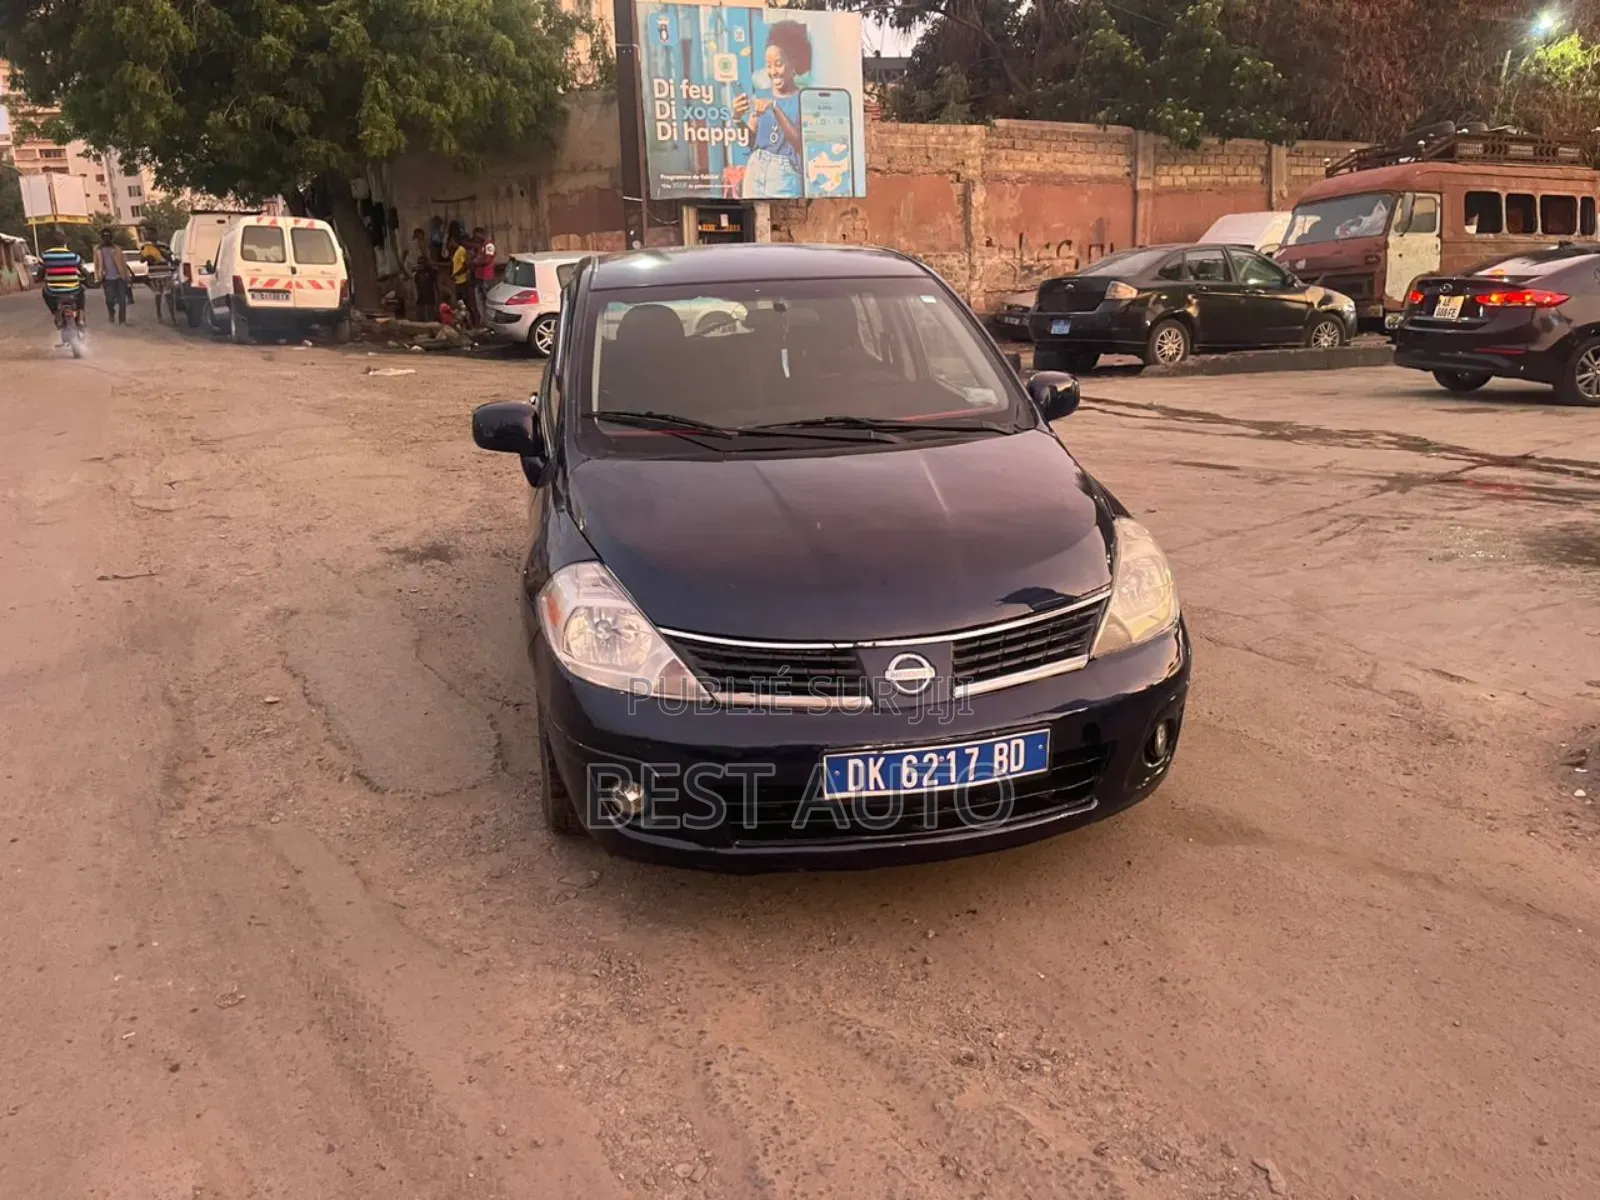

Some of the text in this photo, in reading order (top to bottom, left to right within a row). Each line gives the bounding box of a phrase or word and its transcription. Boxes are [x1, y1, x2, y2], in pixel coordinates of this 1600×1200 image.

[653, 78, 713, 104] Di fey
[655, 100, 729, 120] Di xoos
[656, 121, 749, 147] Di happy
[847, 738, 1025, 792] DK 6217 BD
